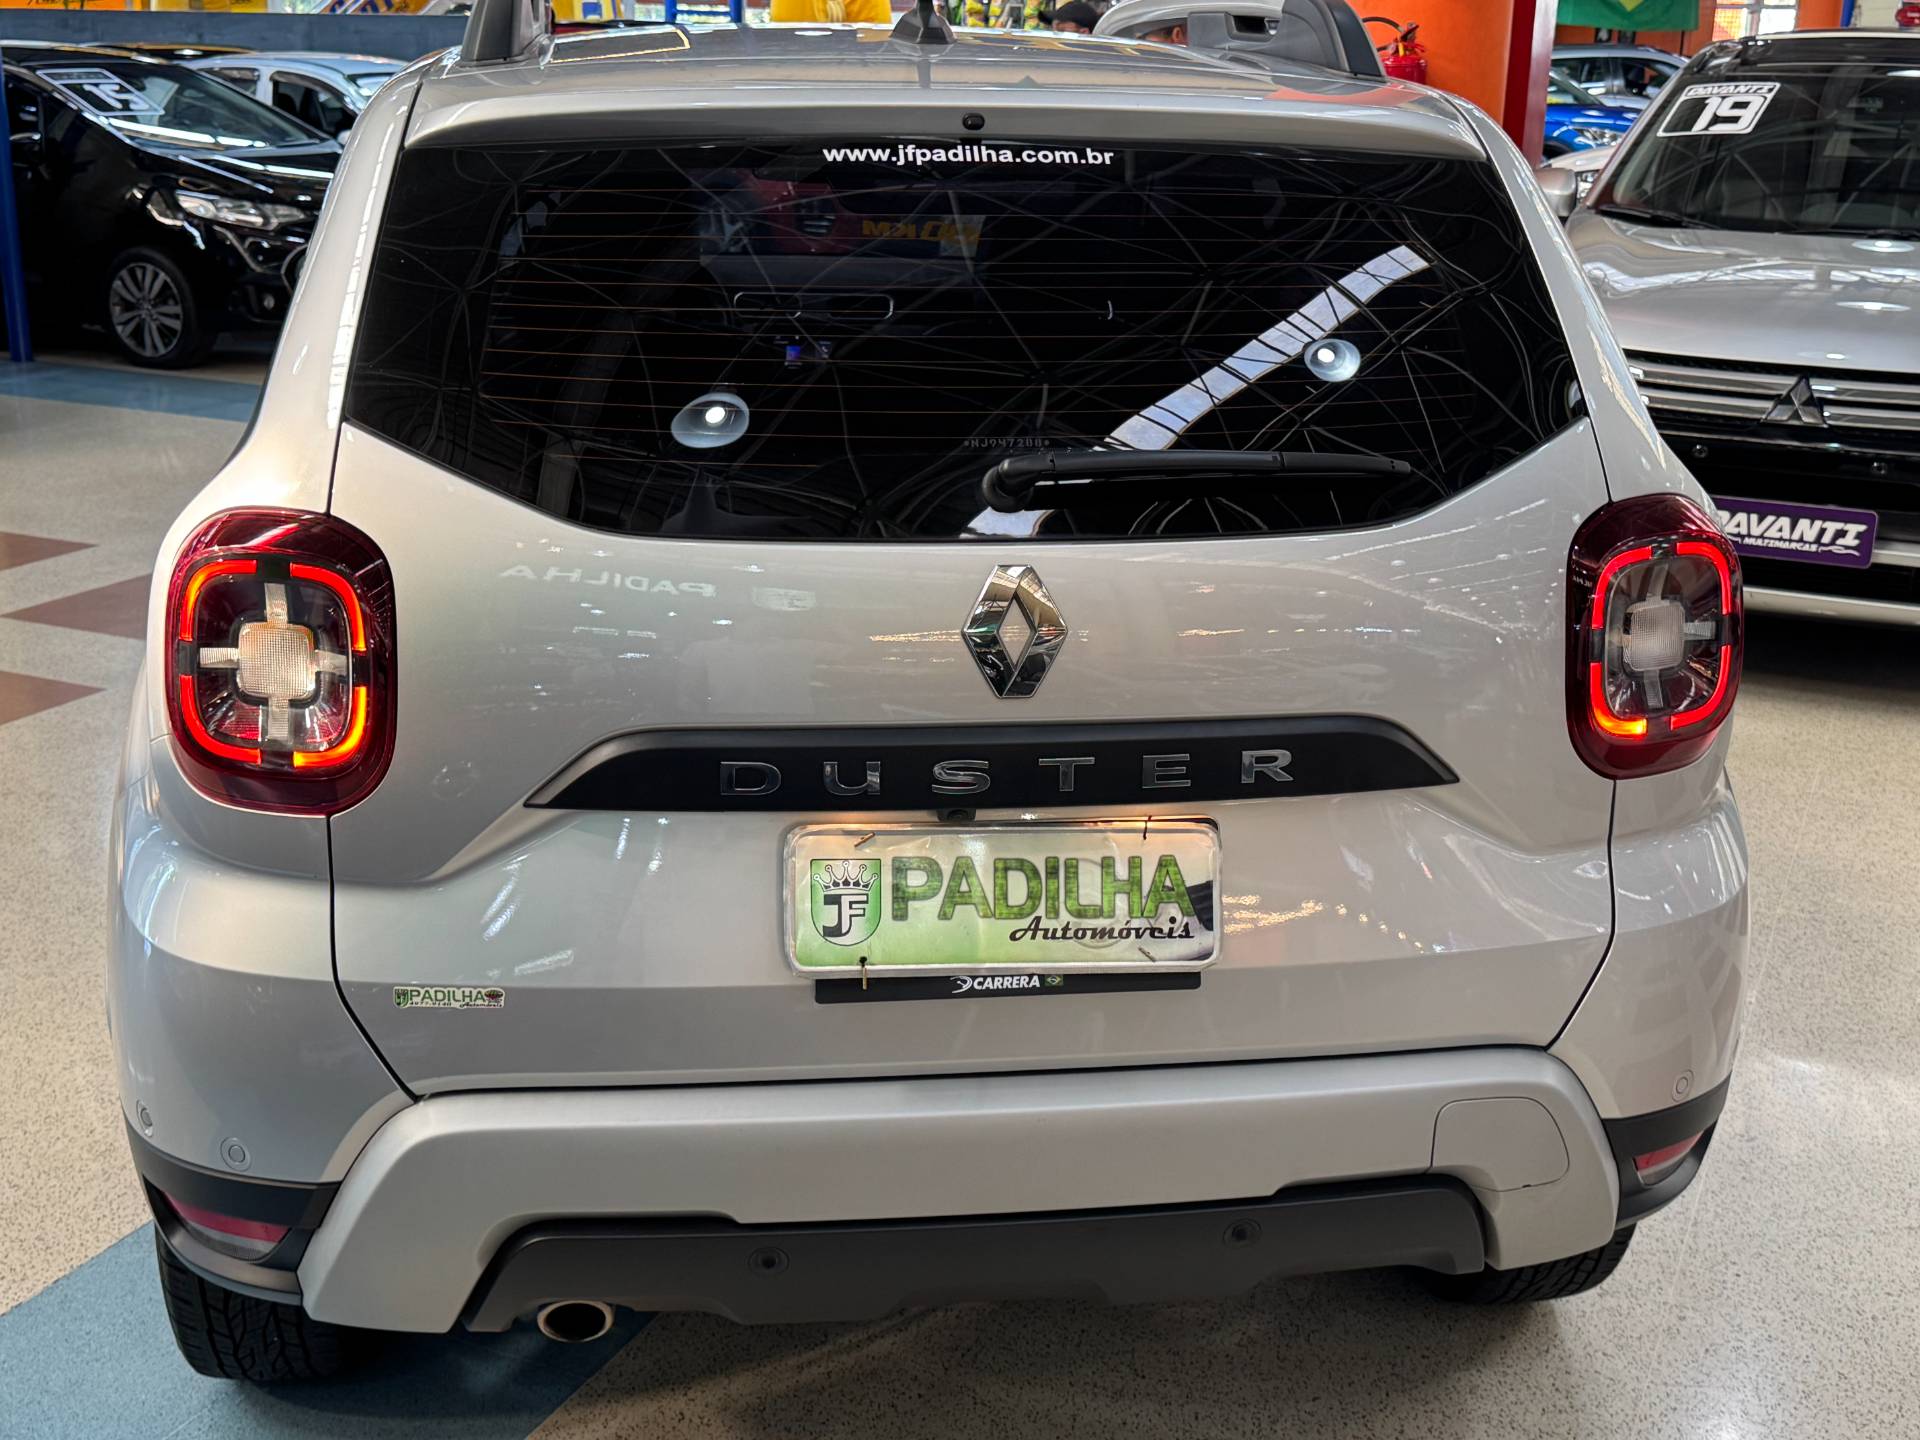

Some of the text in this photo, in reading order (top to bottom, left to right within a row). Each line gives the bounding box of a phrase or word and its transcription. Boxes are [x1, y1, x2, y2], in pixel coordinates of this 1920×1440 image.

[1690, 95, 1766, 133] 19
[822, 144, 1115, 166] www.jfpadilha.com.br
[1743, 536, 1819, 553] MULTIMARCAS
[719, 748, 1294, 797] DUSTER
[890, 853, 1197, 922] PADILHA
[821, 893, 869, 938] JF
[1009, 916, 1195, 942] Automóveis
[973, 974, 1041, 990] CARRERA
[409, 988, 487, 1003] PADILHA
